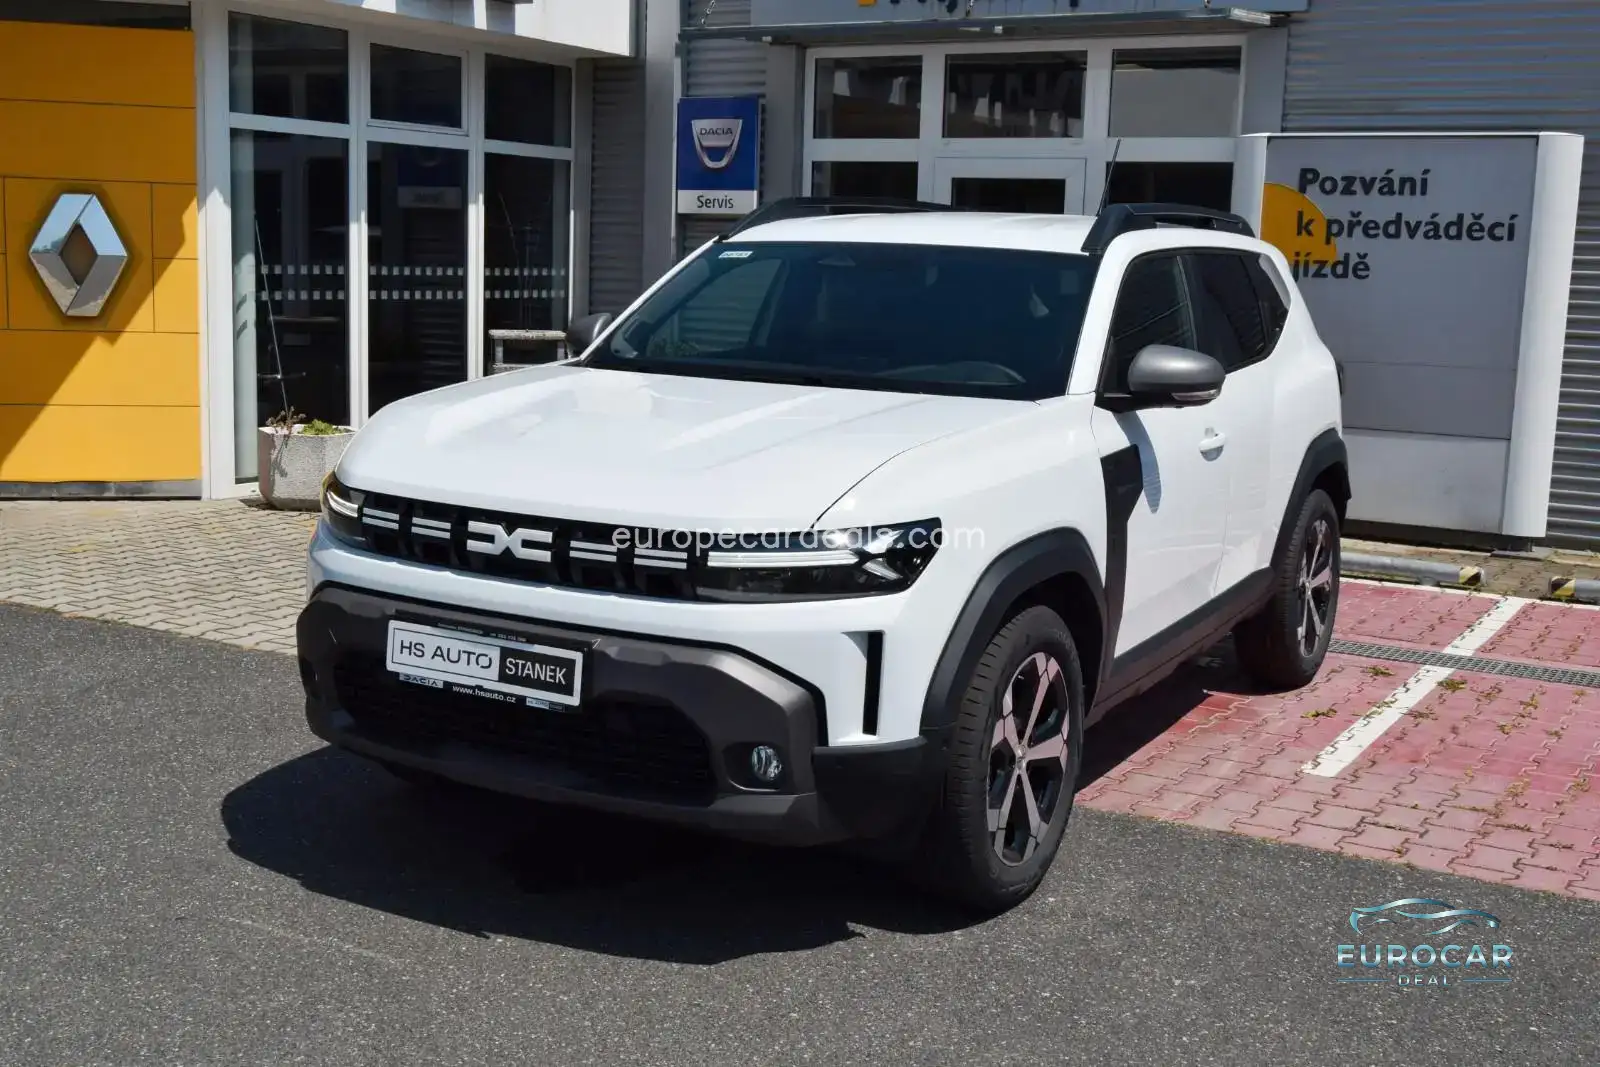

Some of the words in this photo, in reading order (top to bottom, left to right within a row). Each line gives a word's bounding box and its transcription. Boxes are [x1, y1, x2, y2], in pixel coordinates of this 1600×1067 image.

[699, 127, 733, 136] DACIA
[1299, 167, 1431, 197] Pozvání
[696, 195, 734, 209] Servis
[1296, 210, 1314, 237] k
[1325, 211, 1519, 245] předváděcí
[1293, 252, 1370, 282] jízdě
[400, 640, 425, 659] HS
[431, 645, 493, 670] AUTO
[505, 657, 567, 685] STANEK
[452, 684, 517, 704] www.hsauto.cz
